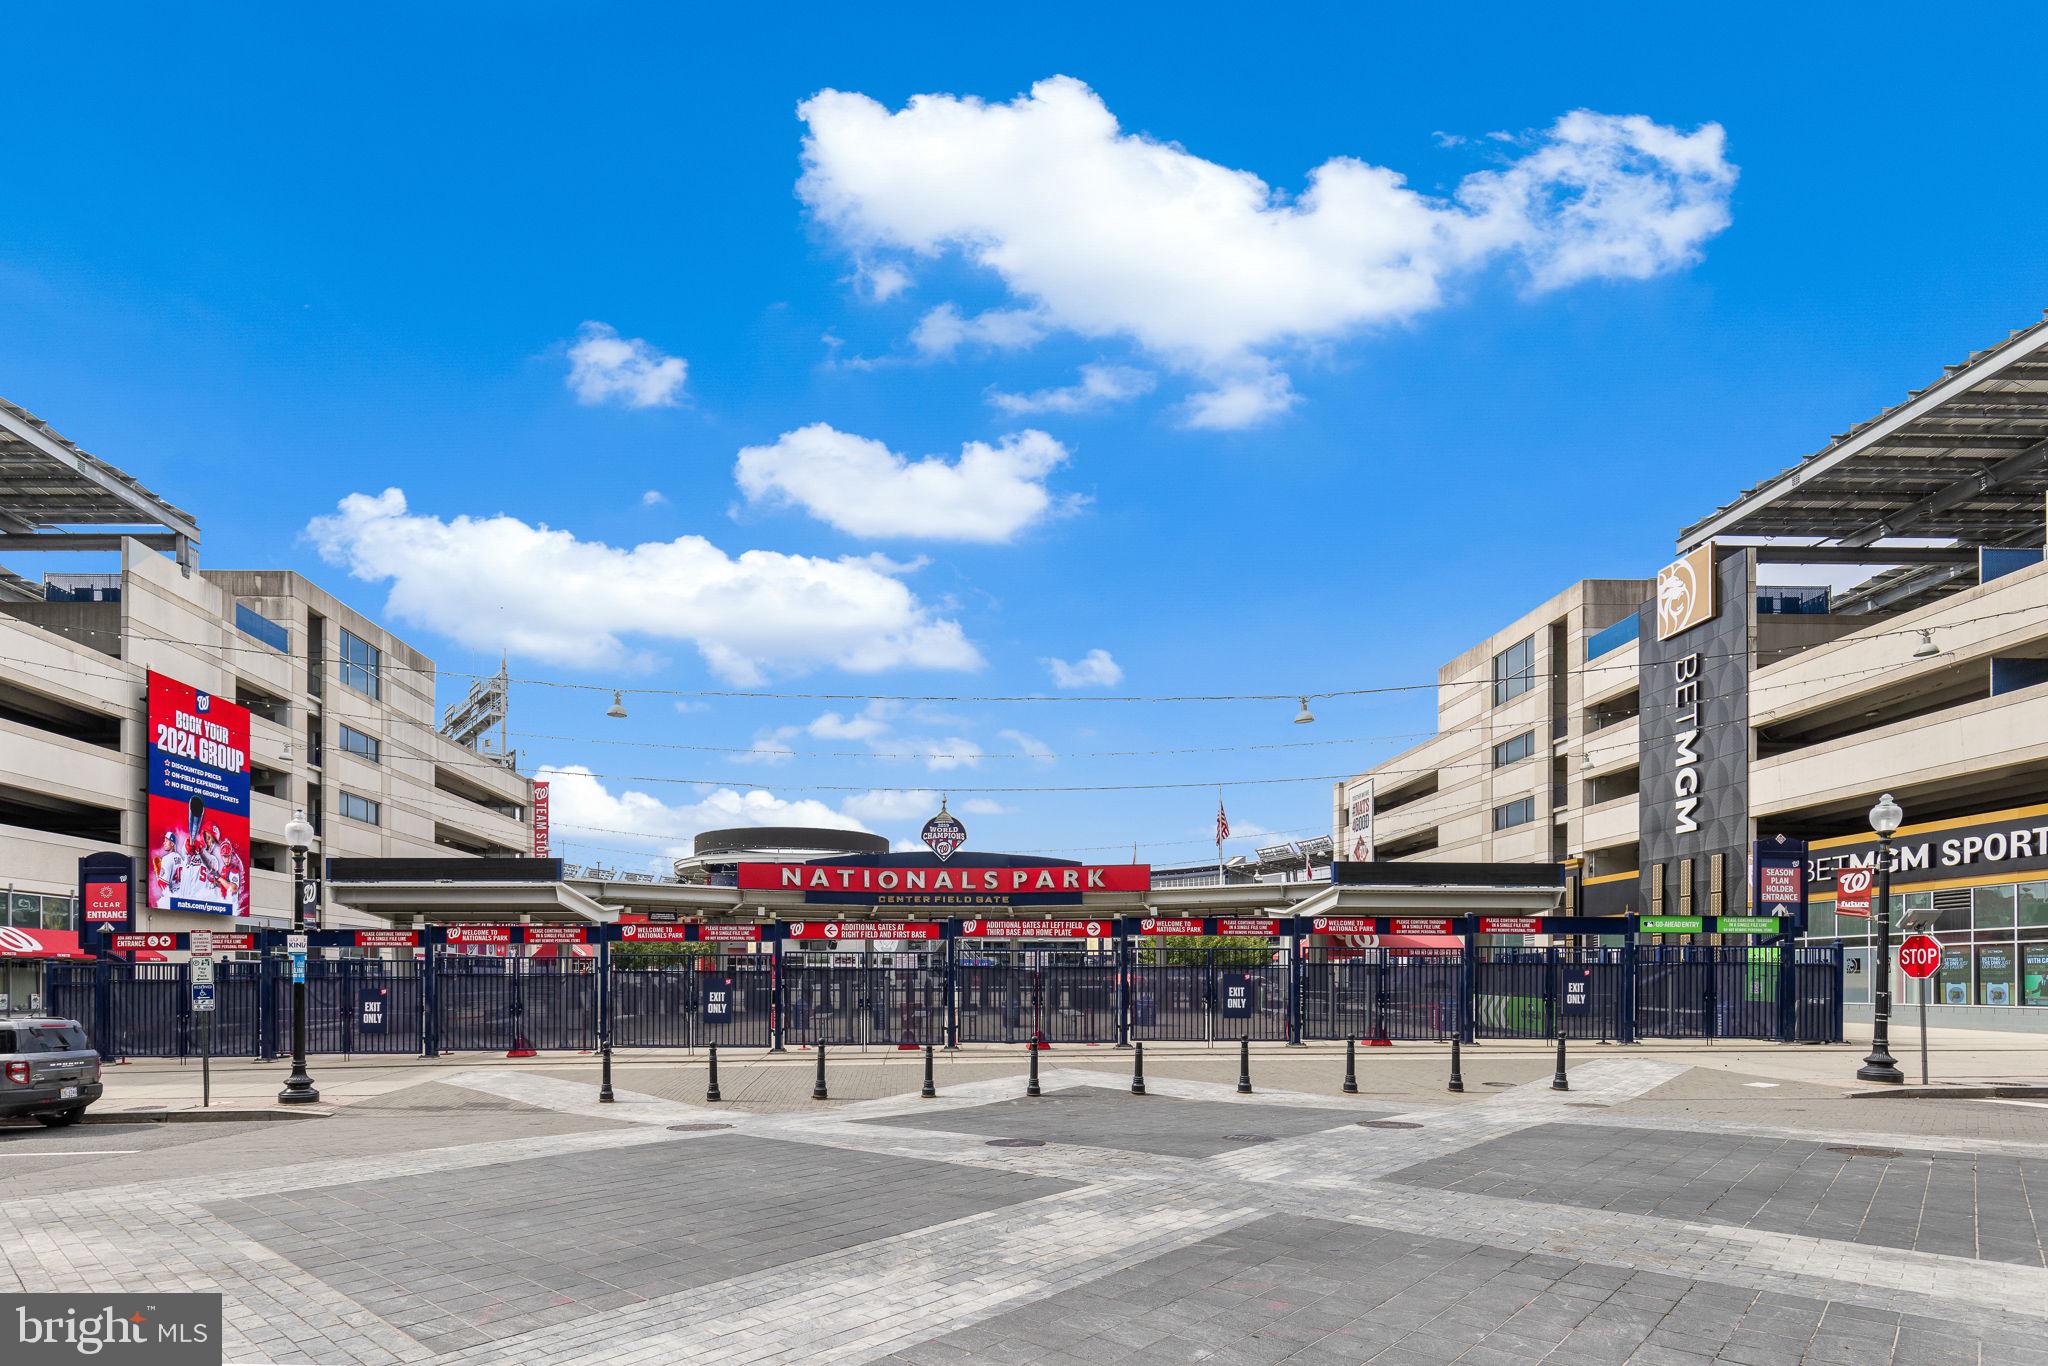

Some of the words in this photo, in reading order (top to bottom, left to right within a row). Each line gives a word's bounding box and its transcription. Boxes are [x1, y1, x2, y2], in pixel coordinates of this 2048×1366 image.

[176, 710, 202, 735] BOOK
[204, 720, 228, 744] YOUR
[158, 724, 196, 759] 2024
[199, 738, 244, 773] GROUP
[1676, 653, 1697, 834] BETMGM
[172, 762, 204, 775] DISCOUNTED
[204, 771, 222, 781] PRICES
[172, 772, 195, 782] ON-FIELD
[196, 779, 228, 792] EXPERIENCES
[180, 784, 193, 792] FEES
[203, 790, 219, 798] GROUP
[220, 794, 239, 804] TICKETS
[536, 802, 547, 830] TEAM
[782, 868, 997, 889] NATIONALS
[1013, 868, 1106, 889] PARK
[178, 901, 226, 912] nats.com/groups
[1066, 921, 1084, 930] FIELD,
[1901, 948, 1936, 965] STOP
[1229, 987, 1245, 996] EXIT
[1569, 983, 1584, 992] EXIT
[709, 992, 725, 1001] EXIT
[1567, 994, 1585, 1004] ONLY
[365, 1002, 381, 1012] EXIT
[708, 1004, 727, 1013] ONLY
[1228, 998, 1246, 1008] ONLY
[363, 1013, 382, 1024] ONLY
